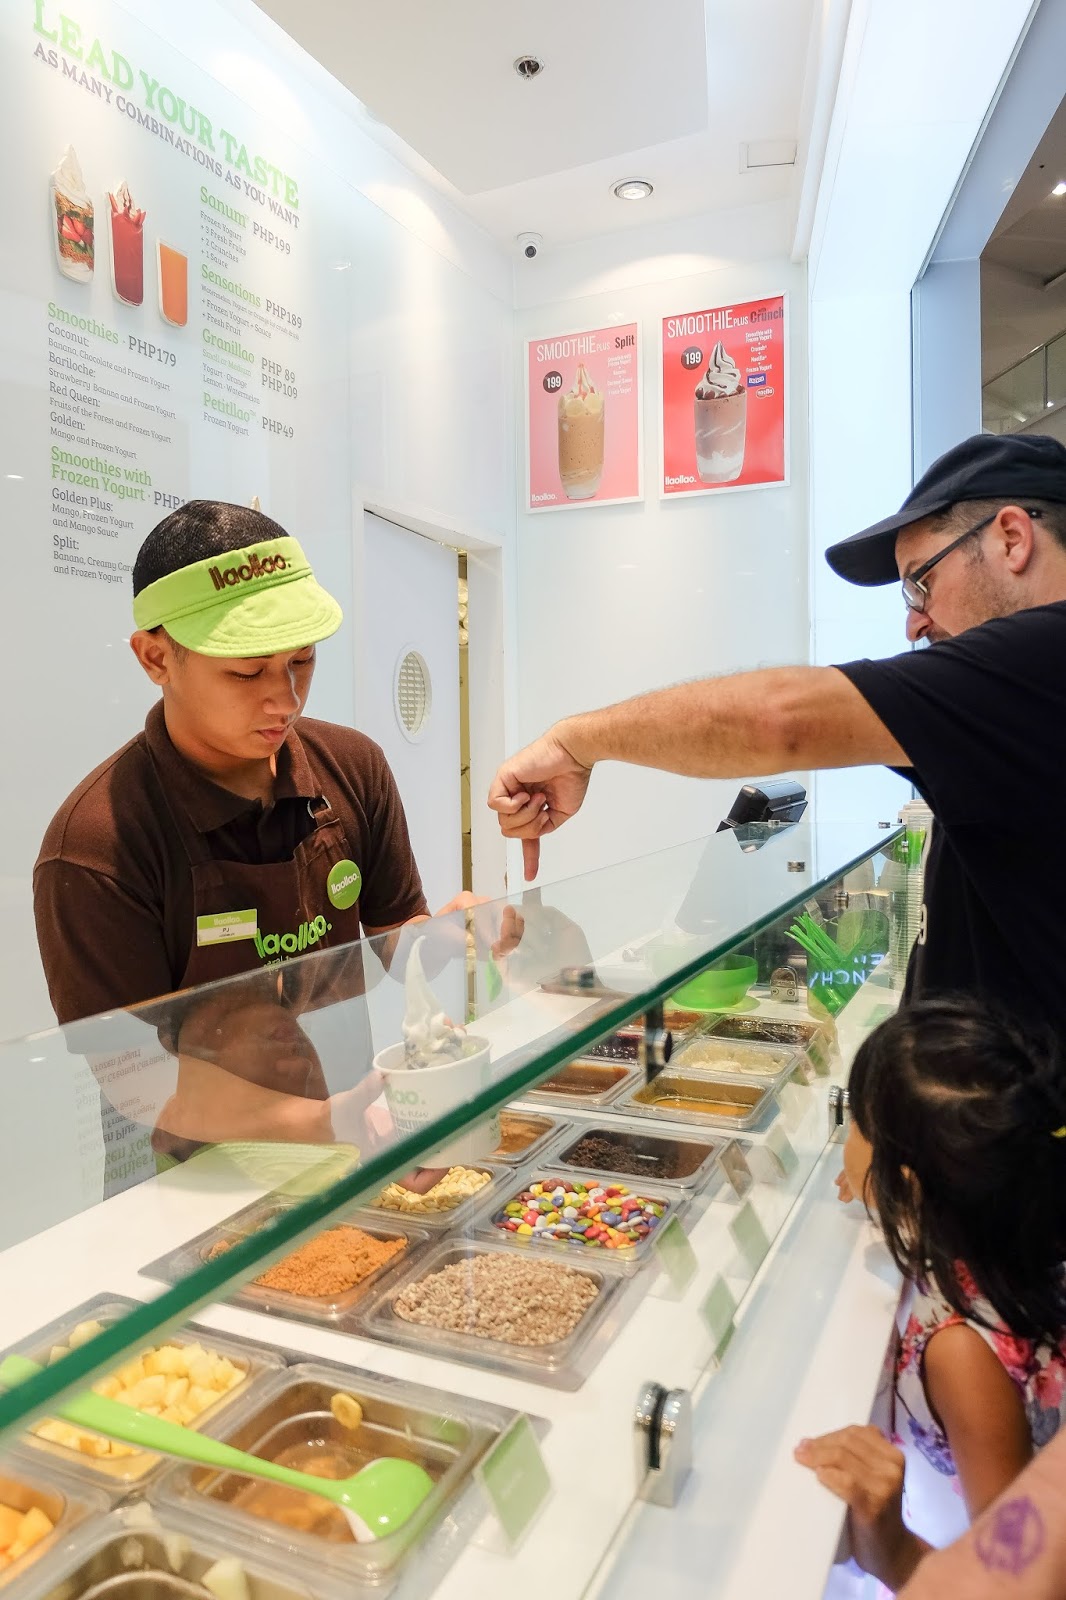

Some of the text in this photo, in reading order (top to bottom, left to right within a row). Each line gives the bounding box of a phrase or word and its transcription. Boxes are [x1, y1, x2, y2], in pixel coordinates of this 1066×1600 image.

[34, 0, 298, 209] LEAD YOUR TASTE
[34, 42, 300, 228] AS MANY COMBINATIONS AS YOU WANT
[200, 210, 242, 241] Frozen Yogurt
[253, 222, 291, 254] PHP199
[210, 229, 227, 244] Fresh
[228, 240, 246, 256] Fruits
[210, 241, 239, 263] Crunches
[201, 264, 302, 328] Sensations PHP189
[207, 300, 228, 315] Frozen
[229, 311, 250, 327] Yogurt
[255, 324, 271, 338] Sauce
[207, 313, 225, 328] Fresh
[226, 323, 241, 336] Fruit
[667, 309, 733, 338] SMOOTHIE
[733, 316, 748, 327] PLUS
[48, 302, 177, 367] Smoothies PHP179
[202, 328, 296, 384] Granillao PHP 89
[536, 335, 596, 362] SMOOTHIE
[597, 341, 611, 352] PLUS
[615, 335, 635, 349] Split
[685, 351, 701, 365] 199
[48, 351, 96, 378] Bariloche:
[79, 349, 113, 369] Chocolate
[114, 363, 126, 375] and
[127, 369, 149, 383] Frozen
[150, 376, 171, 391] Yogurt
[202, 363, 247, 389] Yogurt Orange
[49, 381, 101, 408] Red Queen:
[203, 375, 223, 389] Lemon
[262, 373, 297, 399] PHP109
[547, 375, 561, 389] 199
[93, 383, 119, 400] Banana
[120, 392, 133, 404] and
[133, 398, 155, 412] Frozen
[155, 405, 177, 420] Yogurt
[50, 397, 172, 444] Fruits of the Forest and Frozen Yogurt
[50, 411, 86, 431] Golden:
[203, 412, 250, 436] Frozen Yogurt
[262, 416, 294, 438] PHP49
[50, 427, 138, 460] Mango and Frozen Yogurt
[51, 445, 152, 487] Smoothies with
[665, 474, 697, 485] llaollao.
[51, 464, 100, 490] Frozen
[102, 477, 146, 501] Yogurt
[52, 487, 114, 512] Golden Plus:
[52, 503, 134, 530] Mango, Frozen Yogurt
[52, 518, 119, 538] and Mango Sauce
[53, 535, 80, 550] Split:
[53, 551, 86, 565] Banana,
[87, 557, 117, 572] Creamy
[53, 565, 123, 583] and Frozen Yogurt
[208, 552, 291, 591] llaollao.
[331, 873, 360, 894] llaollao.
